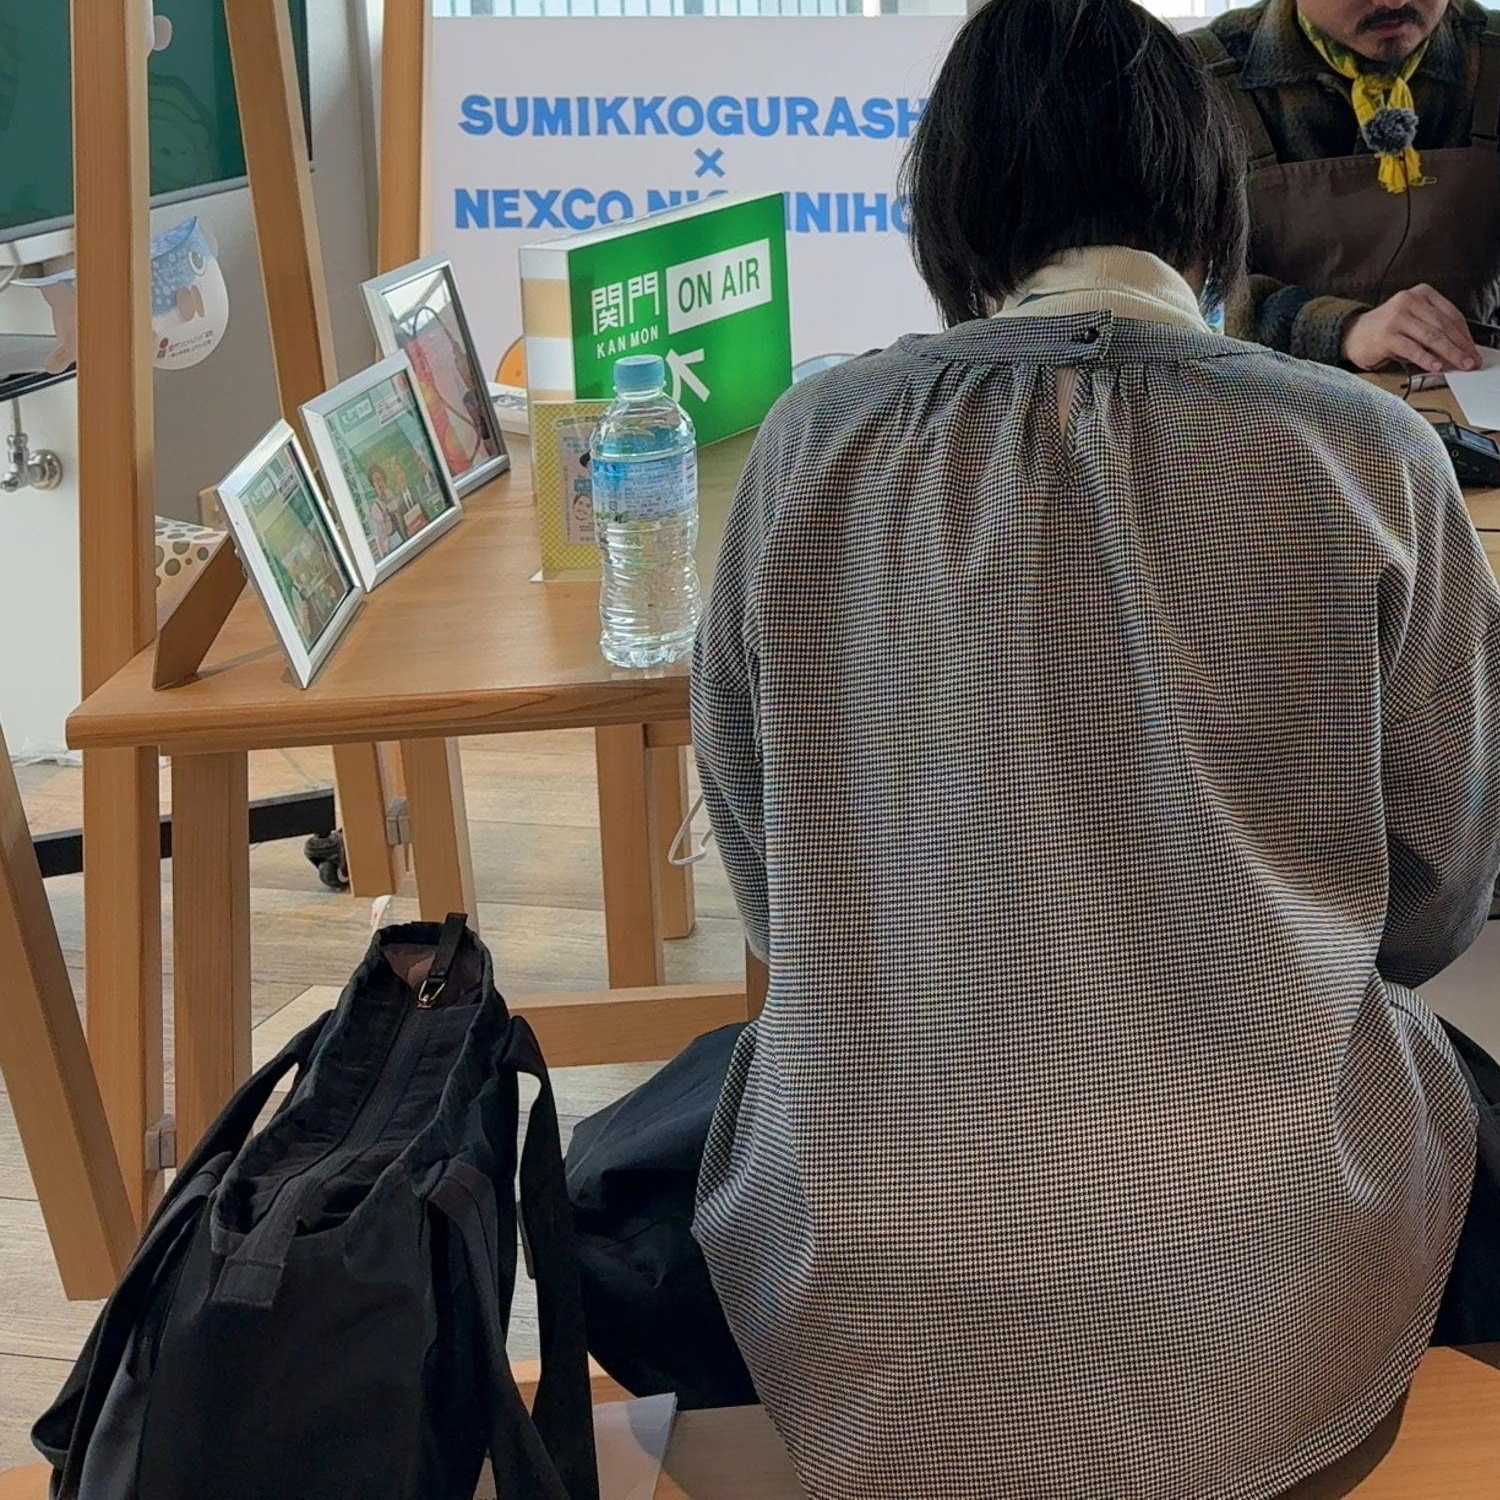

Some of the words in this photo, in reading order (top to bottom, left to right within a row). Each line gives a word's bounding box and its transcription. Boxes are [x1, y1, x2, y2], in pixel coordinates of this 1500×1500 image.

[458, 94, 930, 140] SUMIKKOGURASH
[454, 188, 634, 230] NEXCO
[591, 261, 660, 336] 関門
[678, 270, 712, 314] ON
[721, 257, 760, 301] AIR
